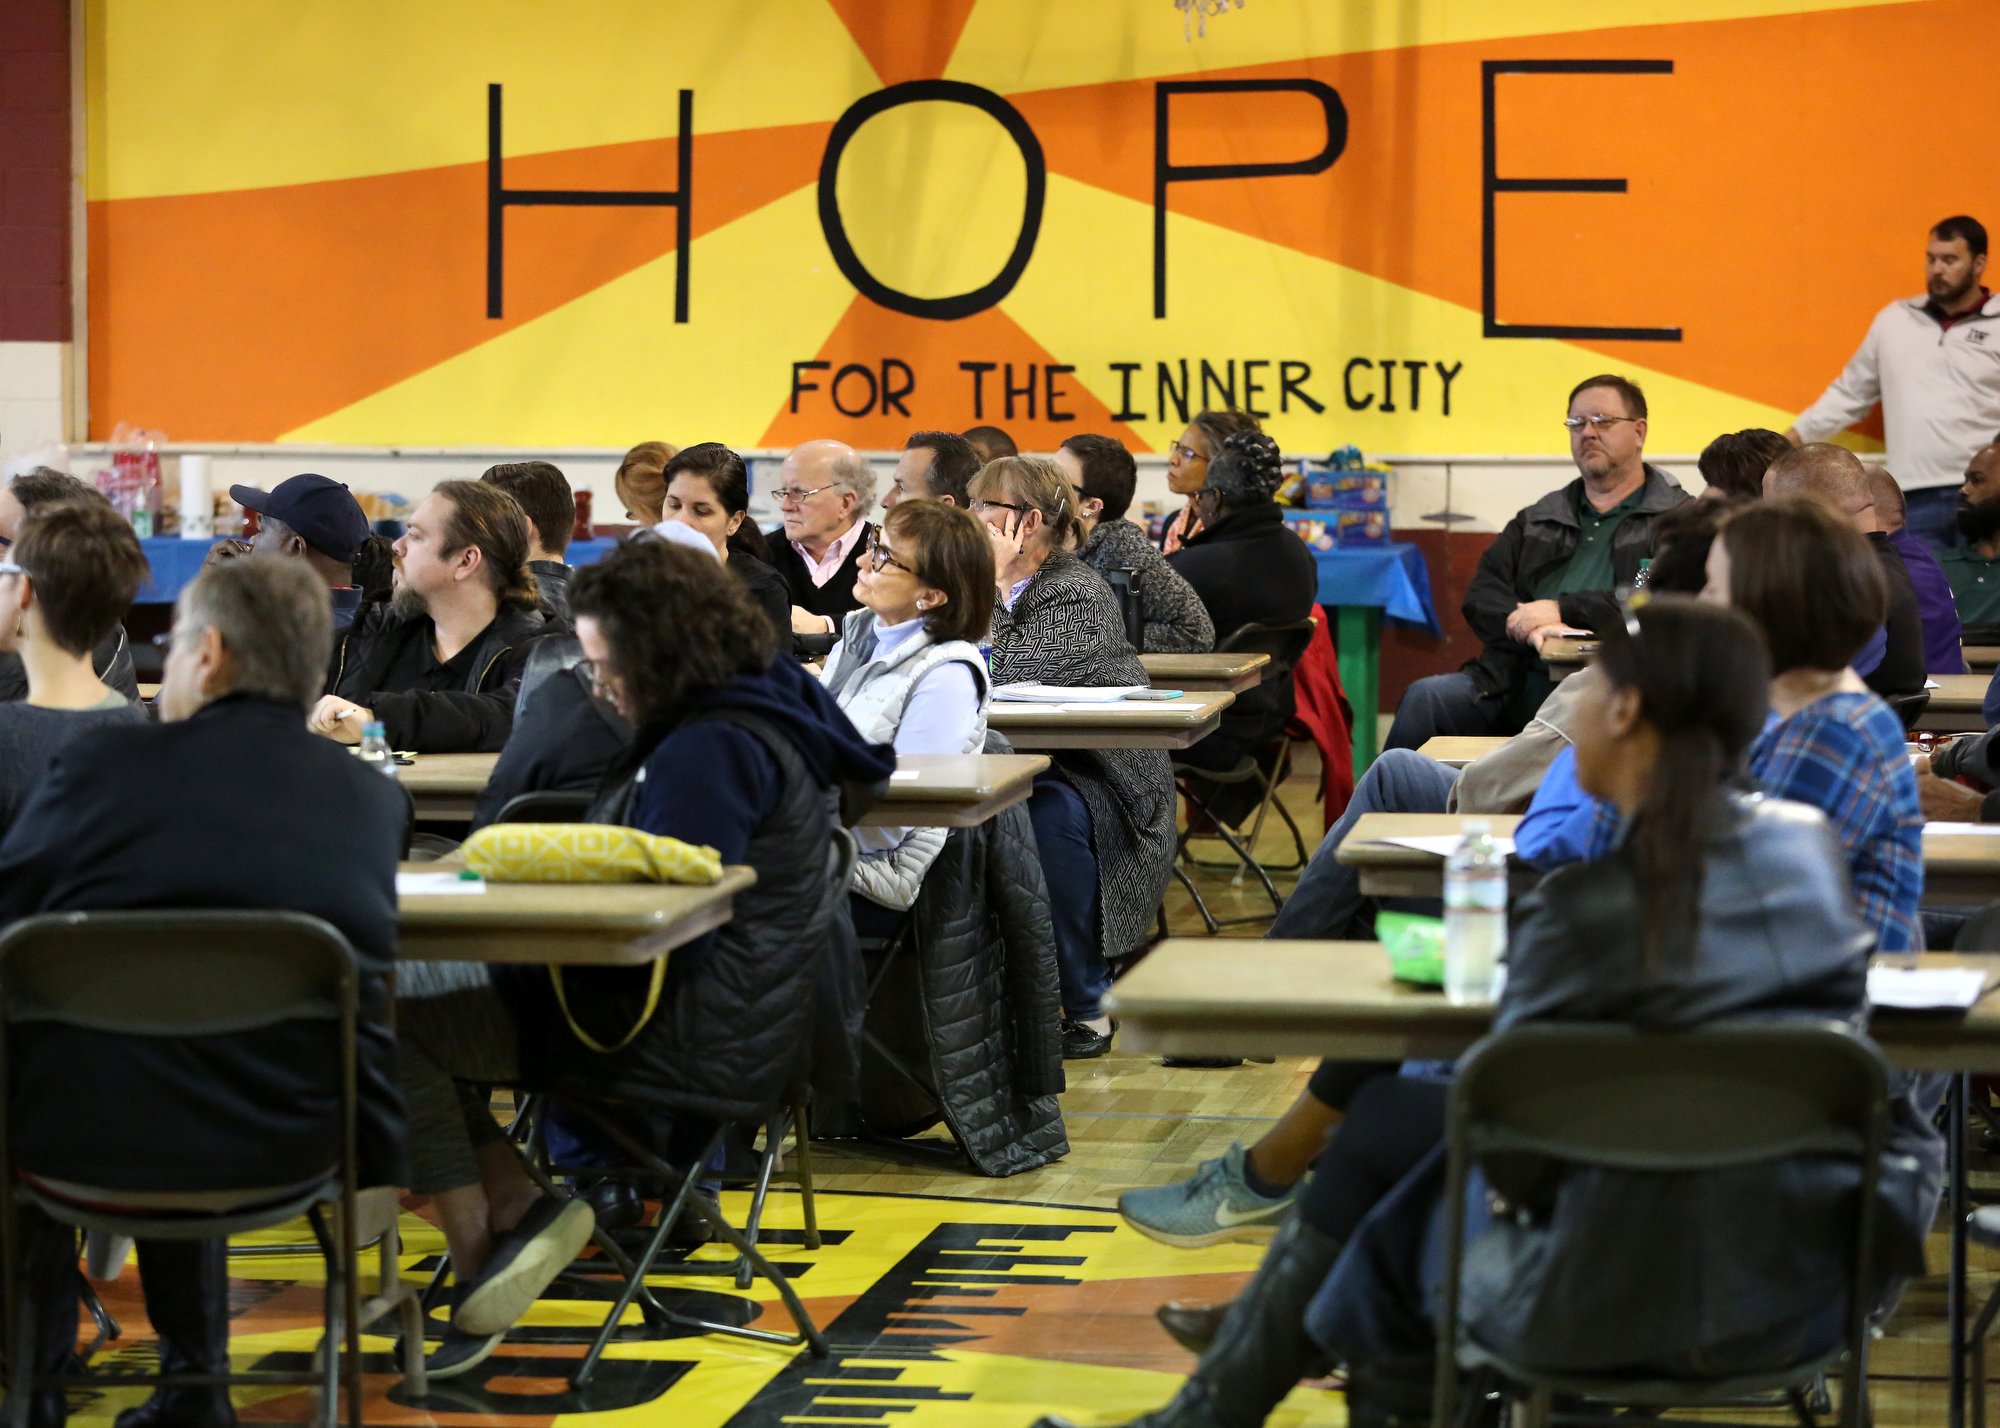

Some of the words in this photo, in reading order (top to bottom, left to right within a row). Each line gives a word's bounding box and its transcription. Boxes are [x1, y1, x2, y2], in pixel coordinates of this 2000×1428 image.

[488, 60, 1682, 341] HOPE
[790, 359, 915, 418] FOR
[959, 362, 1076, 421] THE
[1109, 358, 1325, 424] INNER
[1343, 357, 1462, 417] CITY
